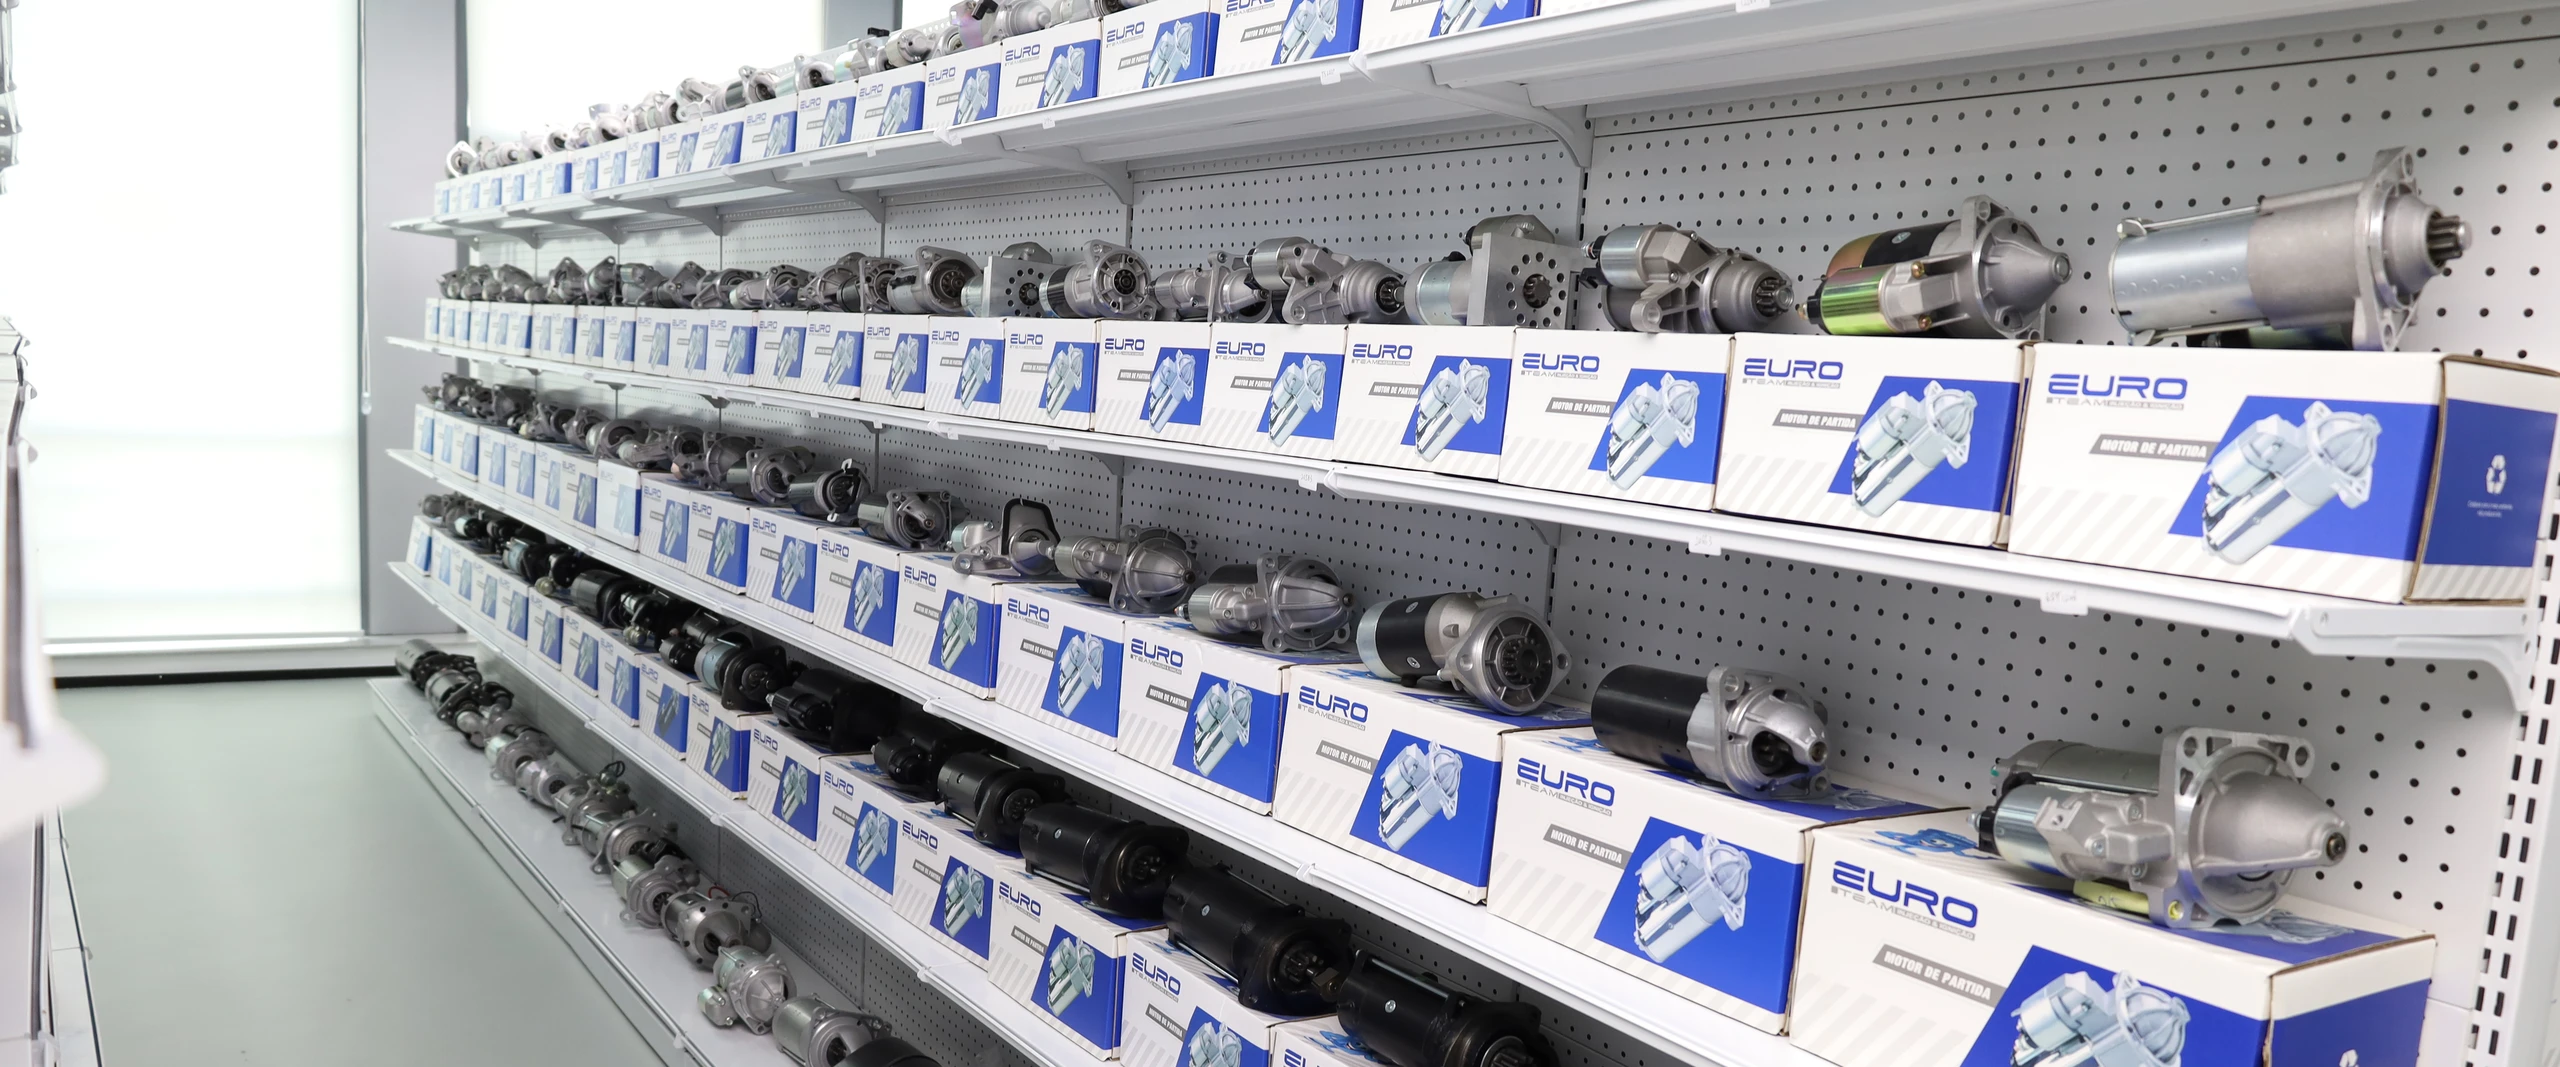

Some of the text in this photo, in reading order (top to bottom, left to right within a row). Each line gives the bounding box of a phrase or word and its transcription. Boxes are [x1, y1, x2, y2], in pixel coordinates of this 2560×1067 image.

[1107, 21, 1145, 43] EURO
[1005, 44, 1040, 62] EURO
[928, 67, 956, 82] EURO
[866, 326, 891, 336] EURO
[931, 330, 959, 341] EURO
[1010, 333, 1043, 345] EURO
[1105, 338, 1145, 351] EURO
[1216, 341, 1265, 356] EURO
[1352, 343, 1413, 360] EURO
[1521, 353, 1600, 372] EURO
[1744, 358, 1843, 380] EURO
[2048, 373, 2188, 400] EURO
[1551, 401, 1610, 415] MOTOR DE PARTIDA
[1780, 413, 1856, 428] MOTOR DE PARTIDA
[2100, 439, 2207, 458] MOTOR DE PARTIDA
[752, 518, 777, 534] EURO
[821, 539, 849, 558] EURO
[904, 565, 937, 587] EURO
[1008, 598, 1050, 623] EURO
[1131, 638, 1183, 668] EURO
[1299, 685, 1368, 723] EURO
[754, 728, 778, 751] EURO
[1321, 745, 1372, 770] MOTOR DE PARTIDA
[824, 771, 854, 796] EURO
[1517, 757, 1615, 807] EURO
[902, 820, 938, 850] EURO
[1551, 829, 1622, 864] MOTOR DE PARTIDA
[999, 881, 1041, 917] EURO
[1832, 860, 1978, 929] EURO
[1132, 952, 1181, 996] EURO
[1884, 951, 1992, 1000] MOTOR DE PARTIDA
